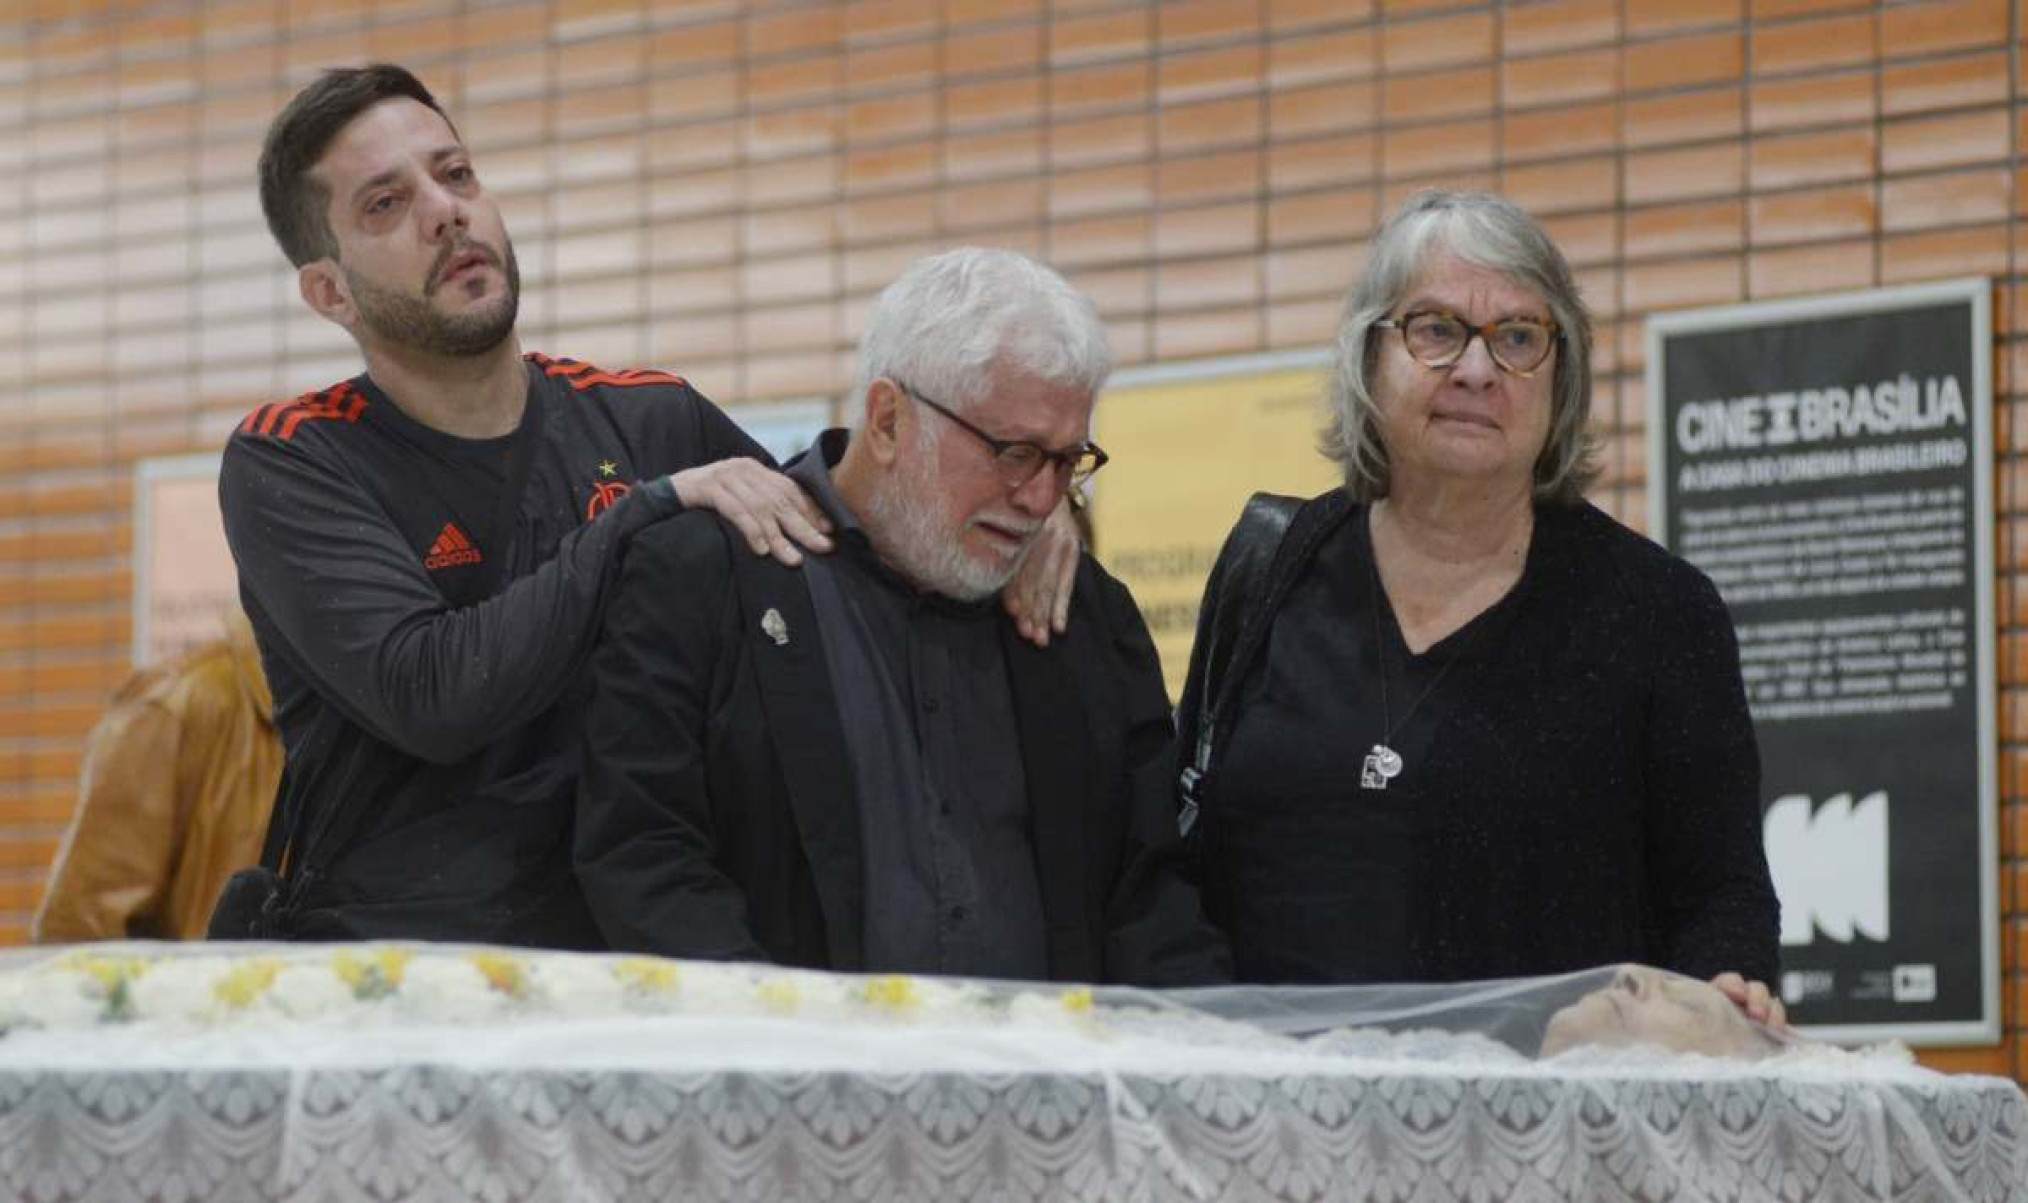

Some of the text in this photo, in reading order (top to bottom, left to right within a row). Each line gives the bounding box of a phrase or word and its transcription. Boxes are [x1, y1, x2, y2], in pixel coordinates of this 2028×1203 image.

[1676, 373, 1967, 454] CINE BRASÍLIA
[1679, 465, 1698, 493] A
[1777, 451, 1851, 484] CINEMA
[1854, 438, 1967, 476] BRASILEIRO
[424, 549, 483, 569] adidas
